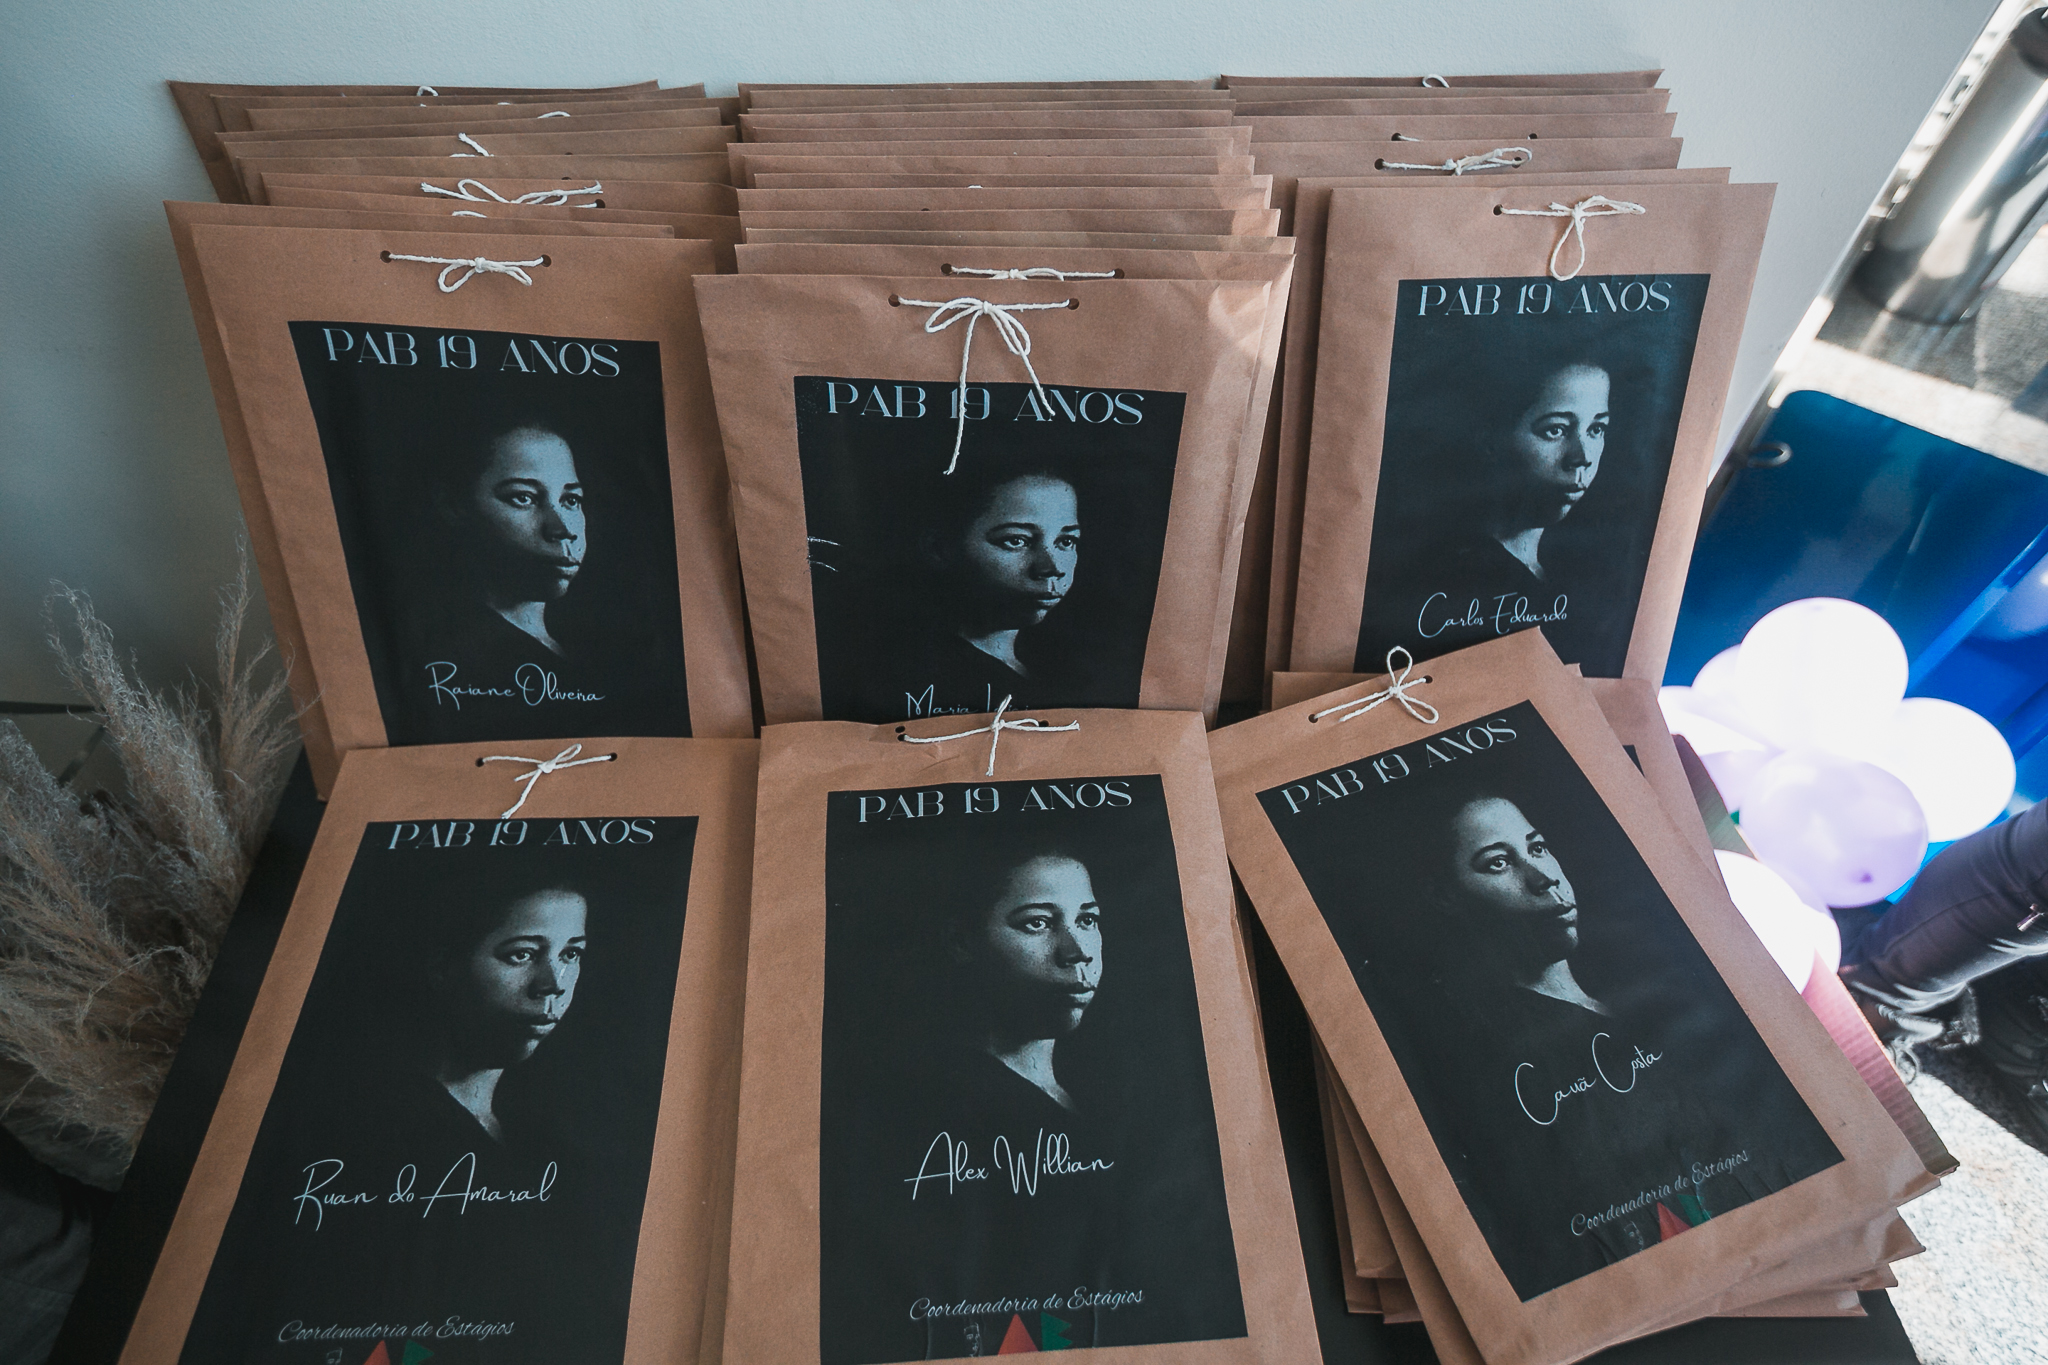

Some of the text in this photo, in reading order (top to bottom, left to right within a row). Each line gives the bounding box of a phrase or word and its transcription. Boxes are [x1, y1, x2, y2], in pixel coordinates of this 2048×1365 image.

[1417, 280, 1673, 317] PAB 19 ANOS
[322, 327, 621, 378] PAB 19 ANOS
[825, 381, 1145, 426] PAB 19 ANOS
[1417, 591, 1568, 639] Carlos Eduardo
[424, 661, 606, 711] Raiane Oliveira
[905, 684, 980, 719] Maria
[1280, 717, 1518, 815] PAB 19 ANOS
[858, 780, 1133, 823] PAB 19 ANOS
[387, 817, 657, 850] PAB 19 ANOS
[1514, 1032, 1664, 1126] Cauã Costa
[903, 1127, 1115, 1201] Alex Willian
[293, 1151, 558, 1232] Ruan do Amaral
[1570, 1149, 1750, 1237] Coordenadoria de Estágios
[908, 1285, 1147, 1321] Coordenadoria de Estágios
[277, 1314, 516, 1343] Coordenadoria de Estágios
